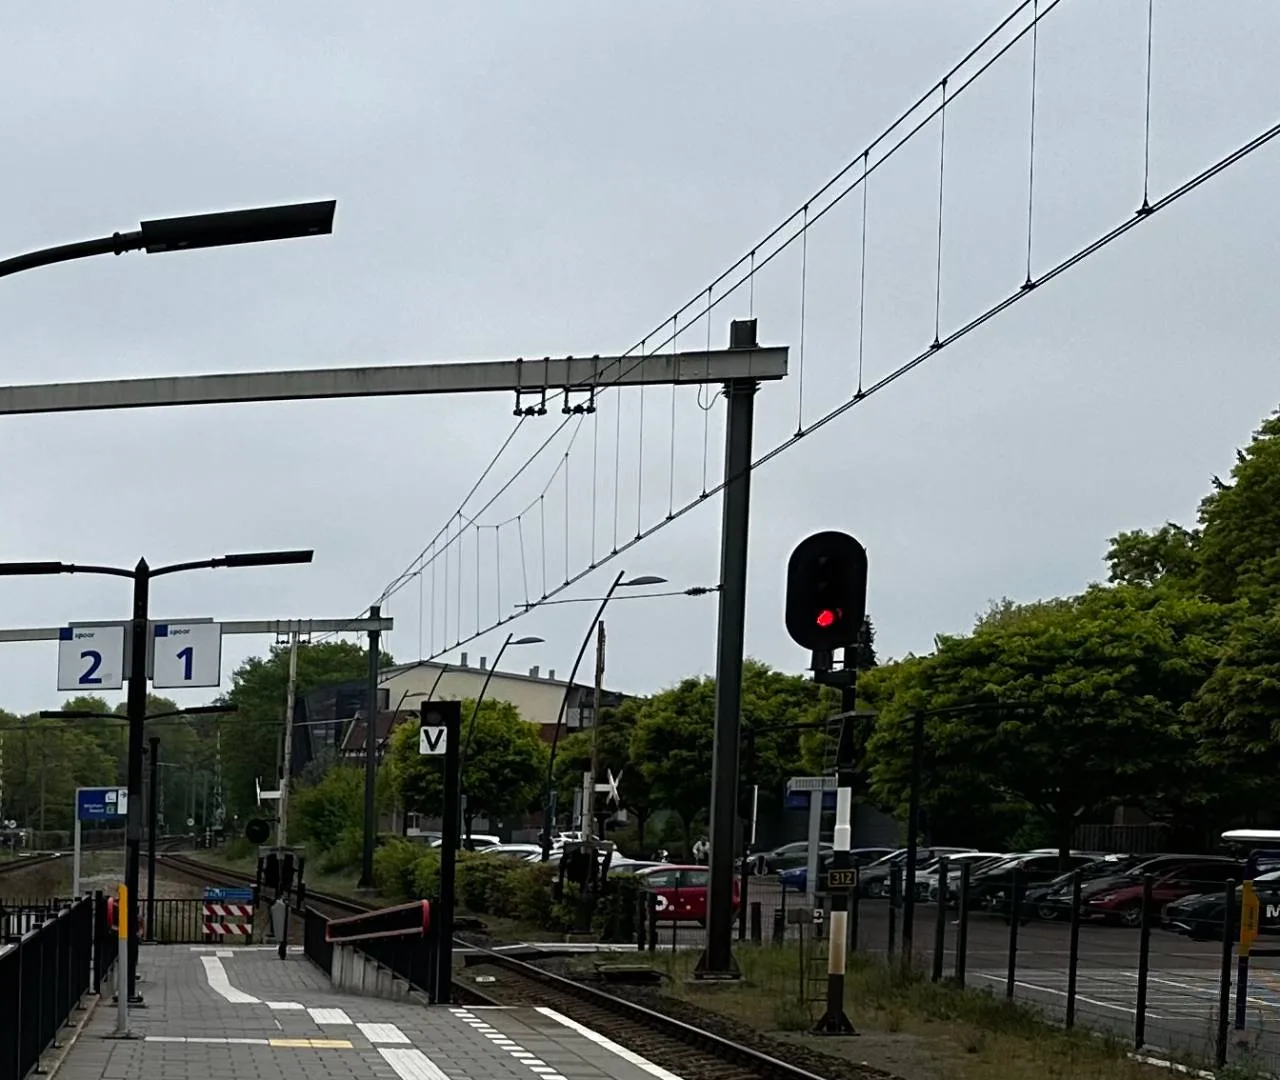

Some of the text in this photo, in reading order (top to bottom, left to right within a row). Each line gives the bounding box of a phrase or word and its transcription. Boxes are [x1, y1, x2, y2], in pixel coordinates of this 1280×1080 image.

[79, 650, 102, 684] 2
[176, 647, 193, 680] 1
[423, 729, 445, 752] V
[832, 872, 853, 884] 312
